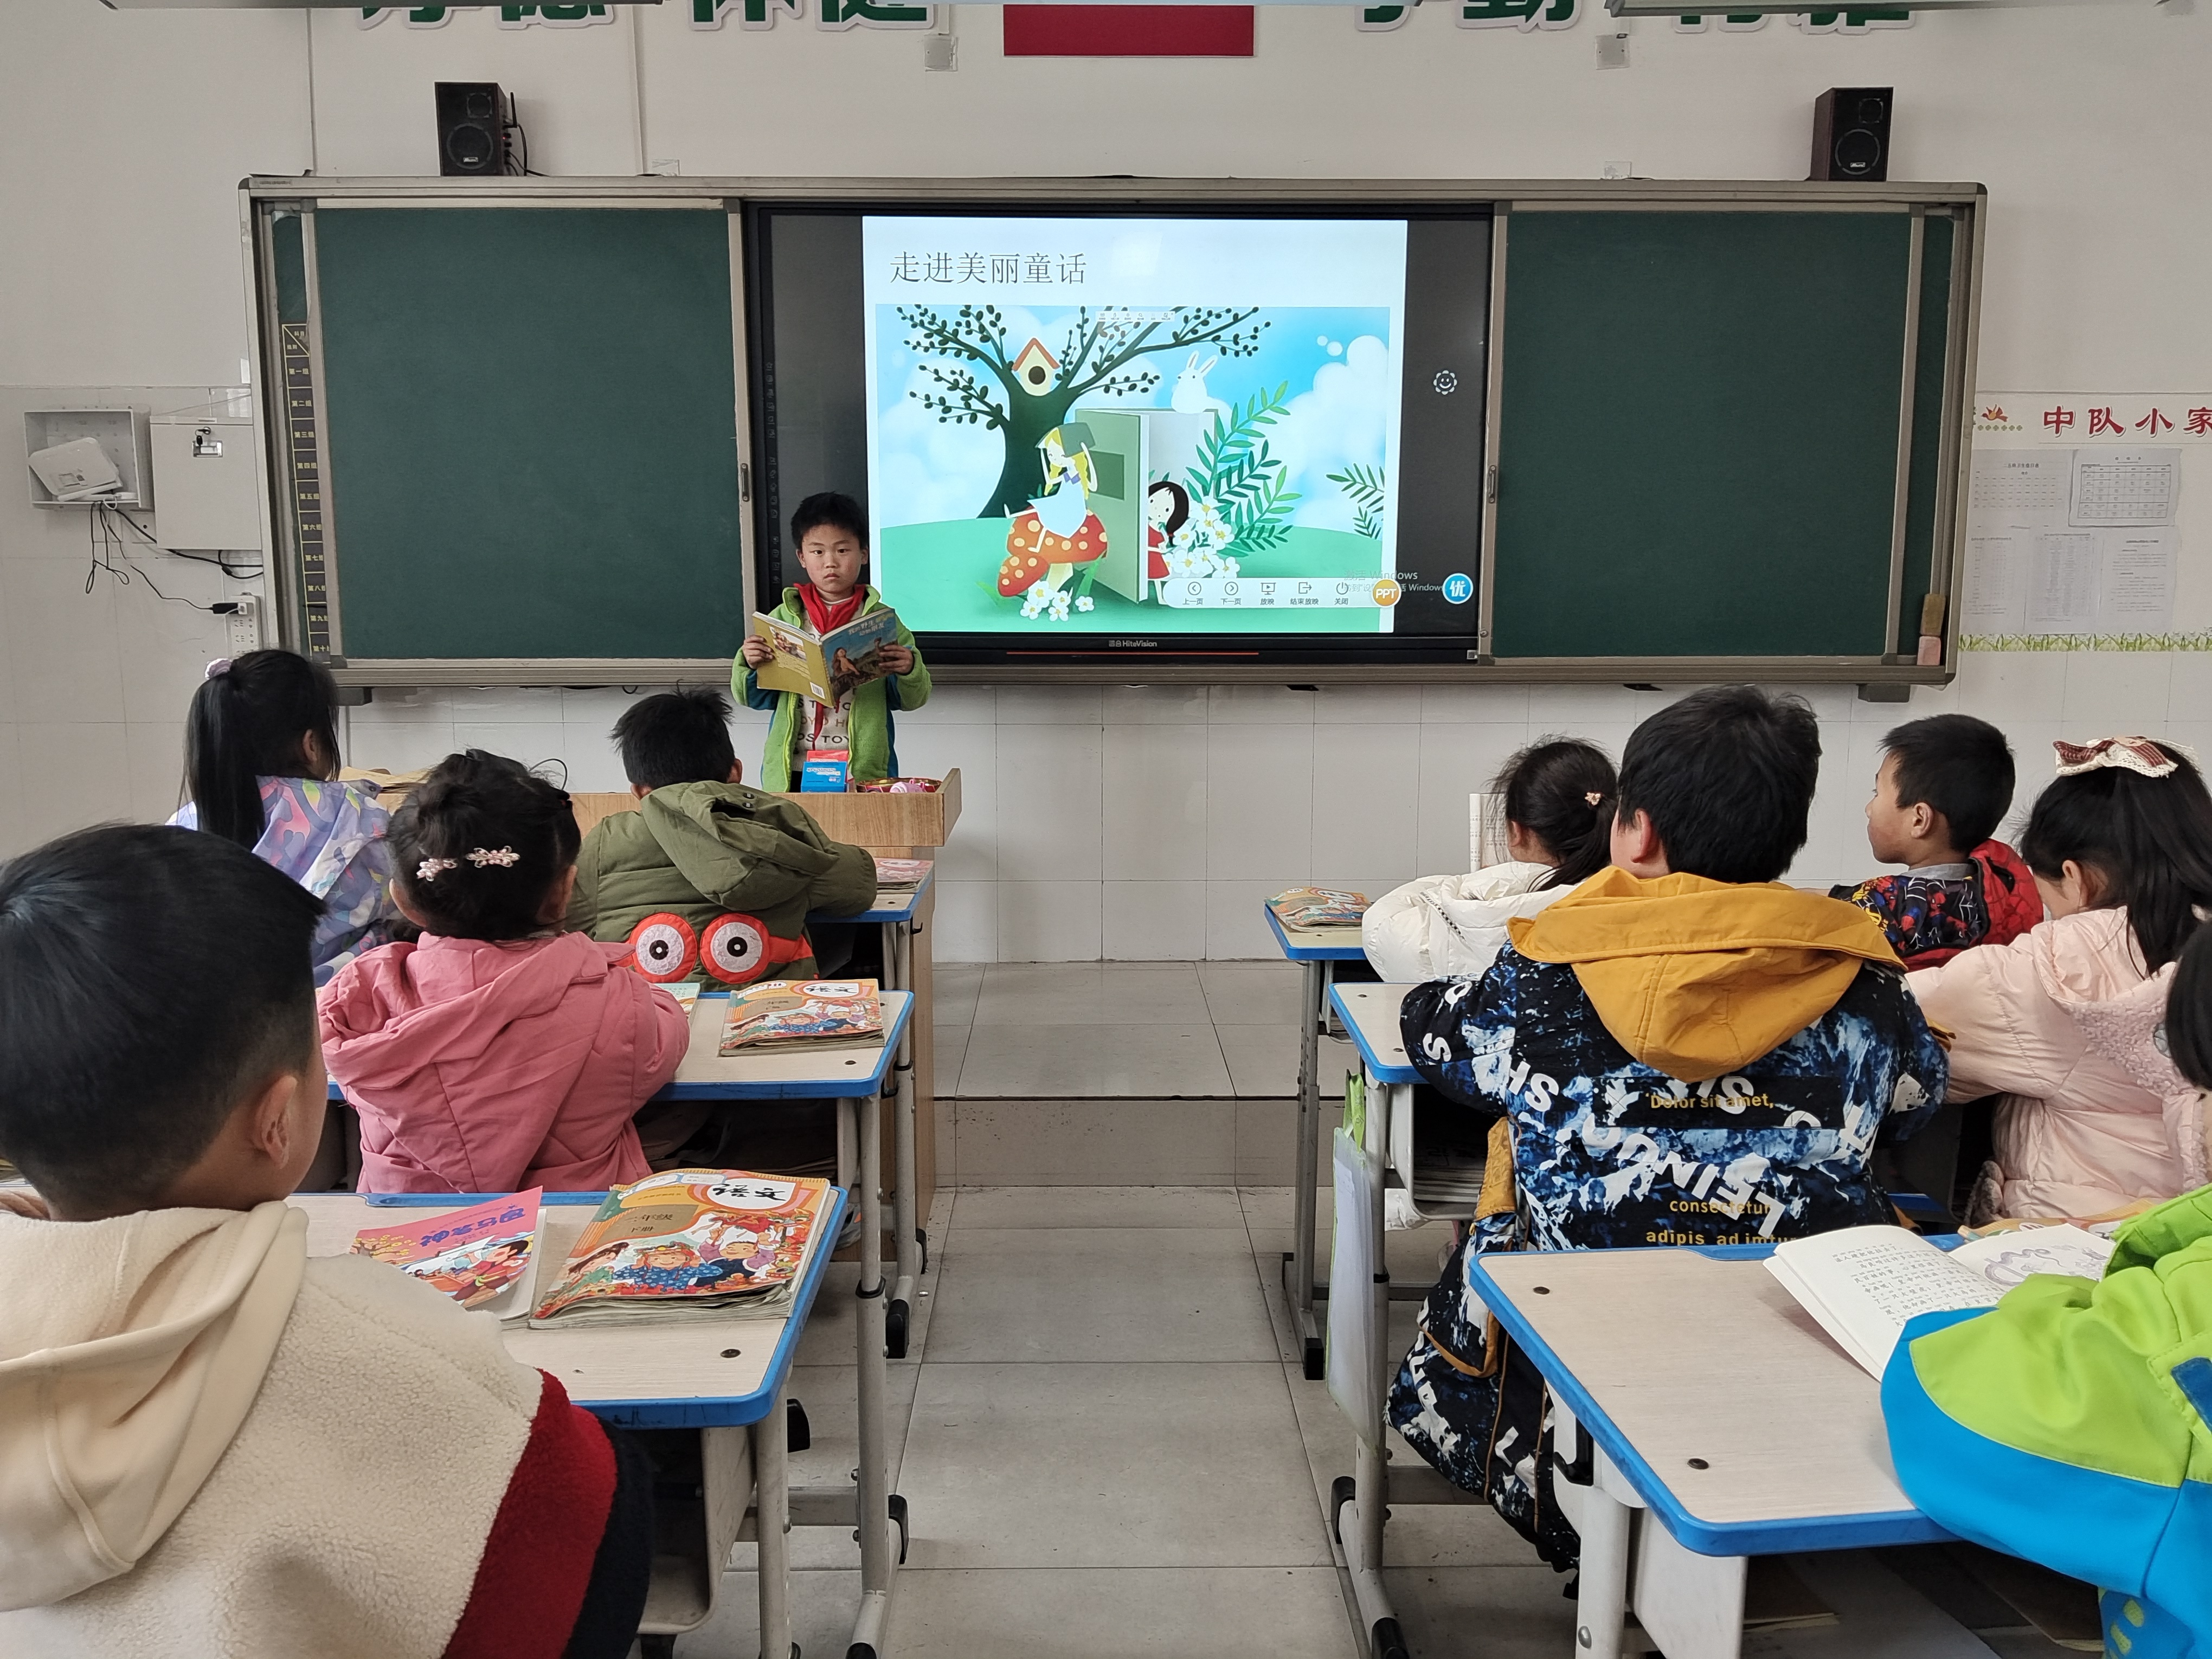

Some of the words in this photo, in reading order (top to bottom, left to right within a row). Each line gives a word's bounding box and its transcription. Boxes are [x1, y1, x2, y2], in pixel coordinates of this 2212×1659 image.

[890, 251, 1087, 285] 走进美丽童话
[2043, 406, 2212, 435] 中队小家
[1370, 570, 1418, 580] Windows
[1375, 588, 1397, 599] PPT
[1450, 580, 1466, 597] 优
[1182, 597, 1203, 606] 上一页
[1220, 597, 1242, 606] 下一页
[713, 1184, 786, 1201] 语文
[1669, 1199, 1771, 1214] consectetur
[1645, 1230, 1705, 1246] adipis
[1716, 1233, 1739, 1245] ad
